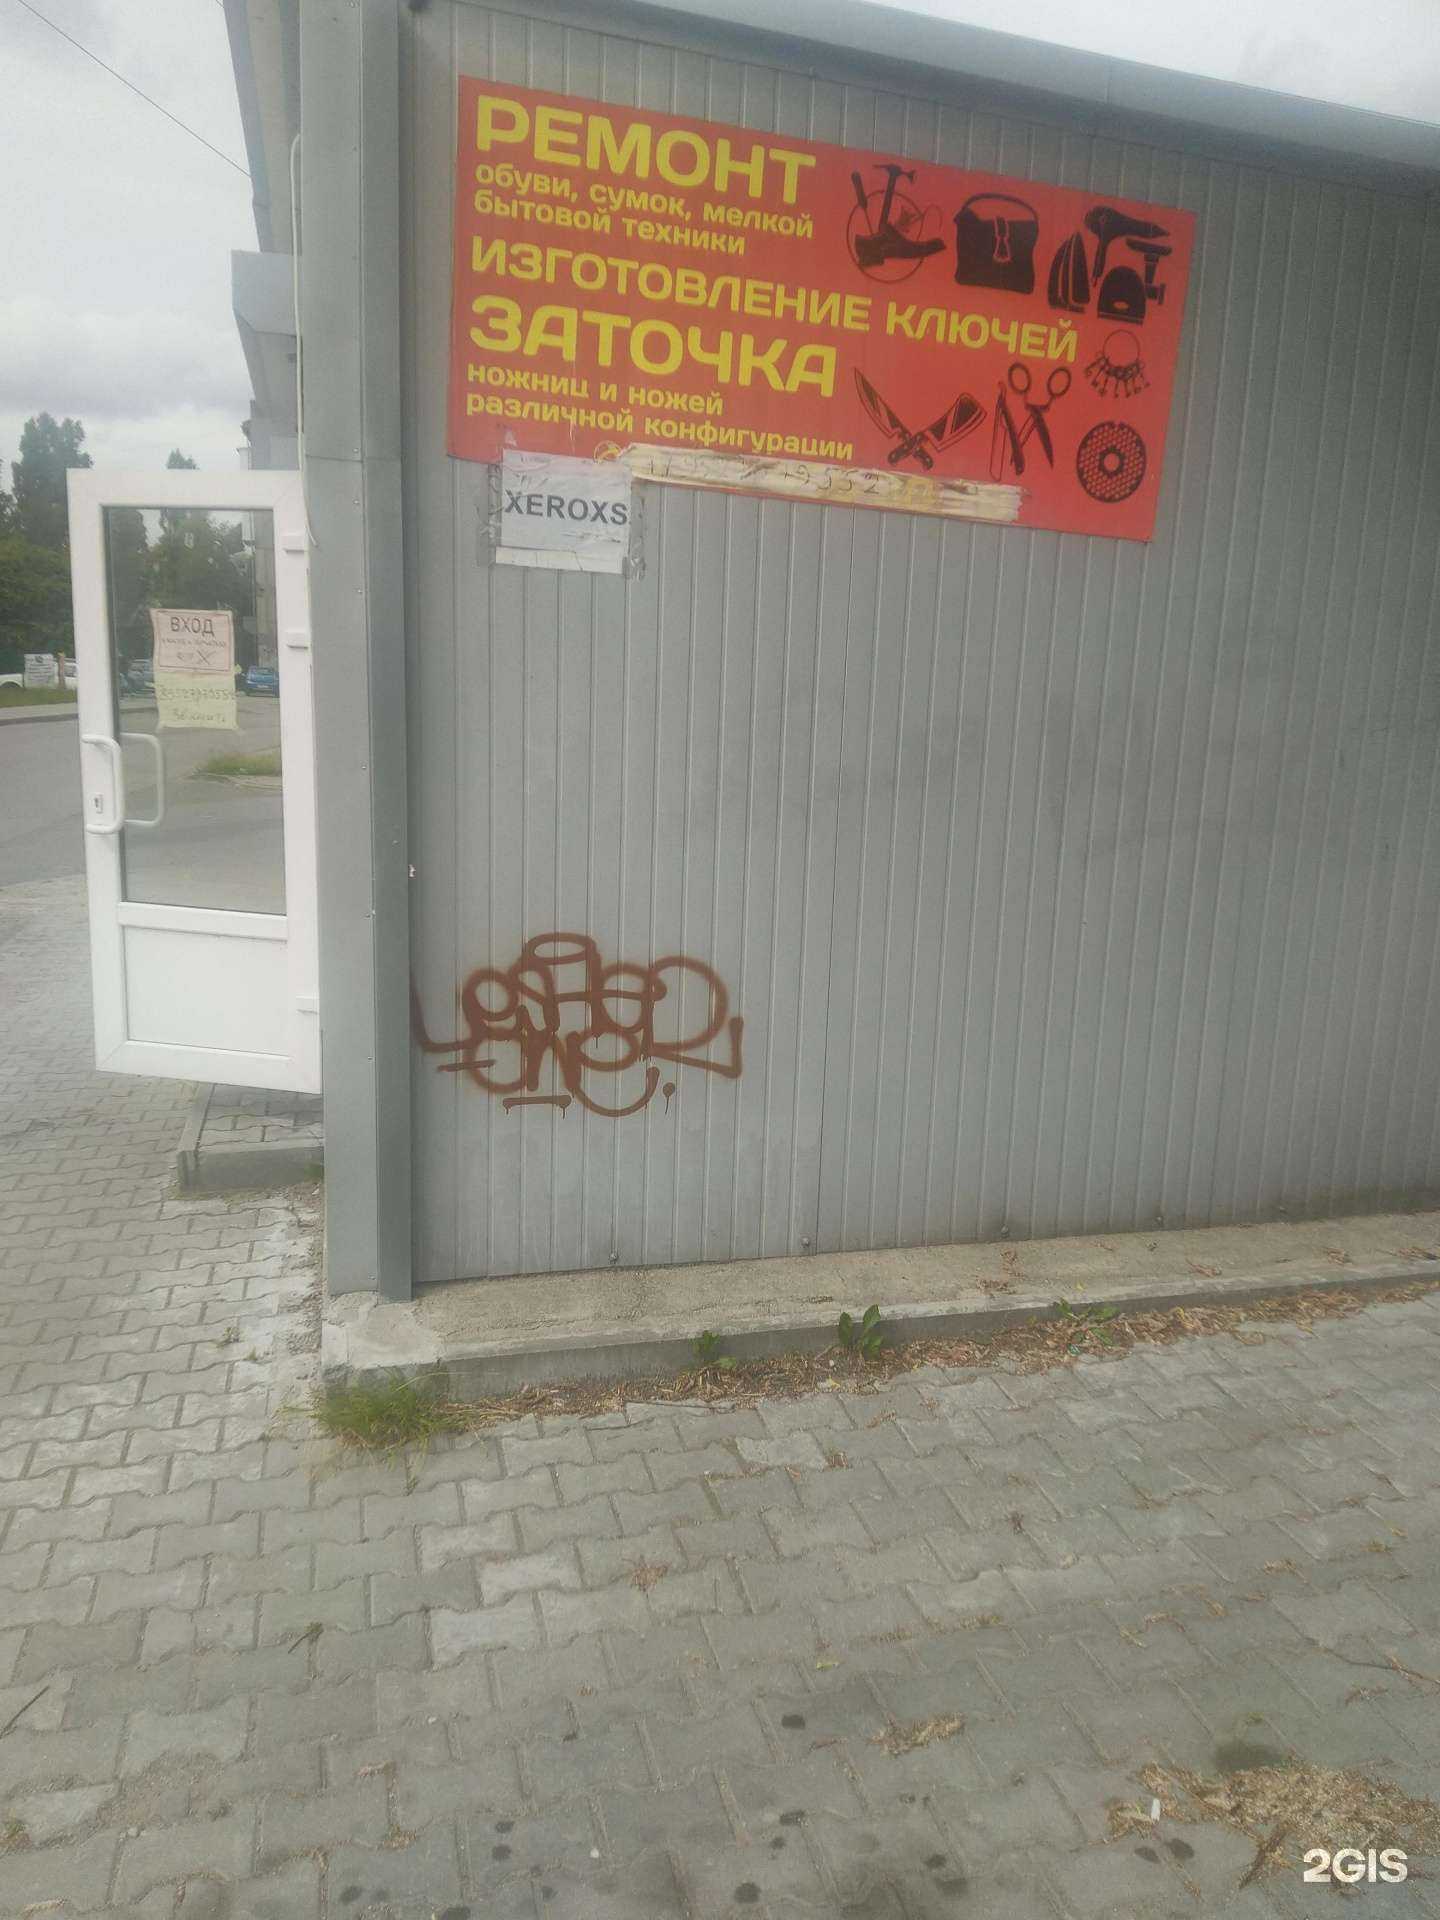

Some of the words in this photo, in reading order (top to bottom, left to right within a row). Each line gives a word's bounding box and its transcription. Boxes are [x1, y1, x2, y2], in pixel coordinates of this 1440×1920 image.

[477, 95, 816, 205] РЕМОНТ
[474, 190, 611, 234] бытовой
[622, 217, 746, 256] техники
[475, 163, 578, 202] обуви,
[589, 183, 692, 221] сумок,
[703, 202, 814, 239] мелкой
[471, 236, 872, 332] ИЗГОТОВЛЕНИЕ
[886, 302, 1077, 363] КЛЮЧЕЙ
[469, 295, 837, 397] ЗАТОЧКА
[467, 363, 589, 399] ножниц
[599, 383, 618, 402] и
[628, 387, 724, 417] ножей
[466, 393, 634, 433] различной
[645, 410, 853, 461] конфигурации
[504, 489, 628, 526] XEROXS
[169, 616, 215, 638] ВХОД
